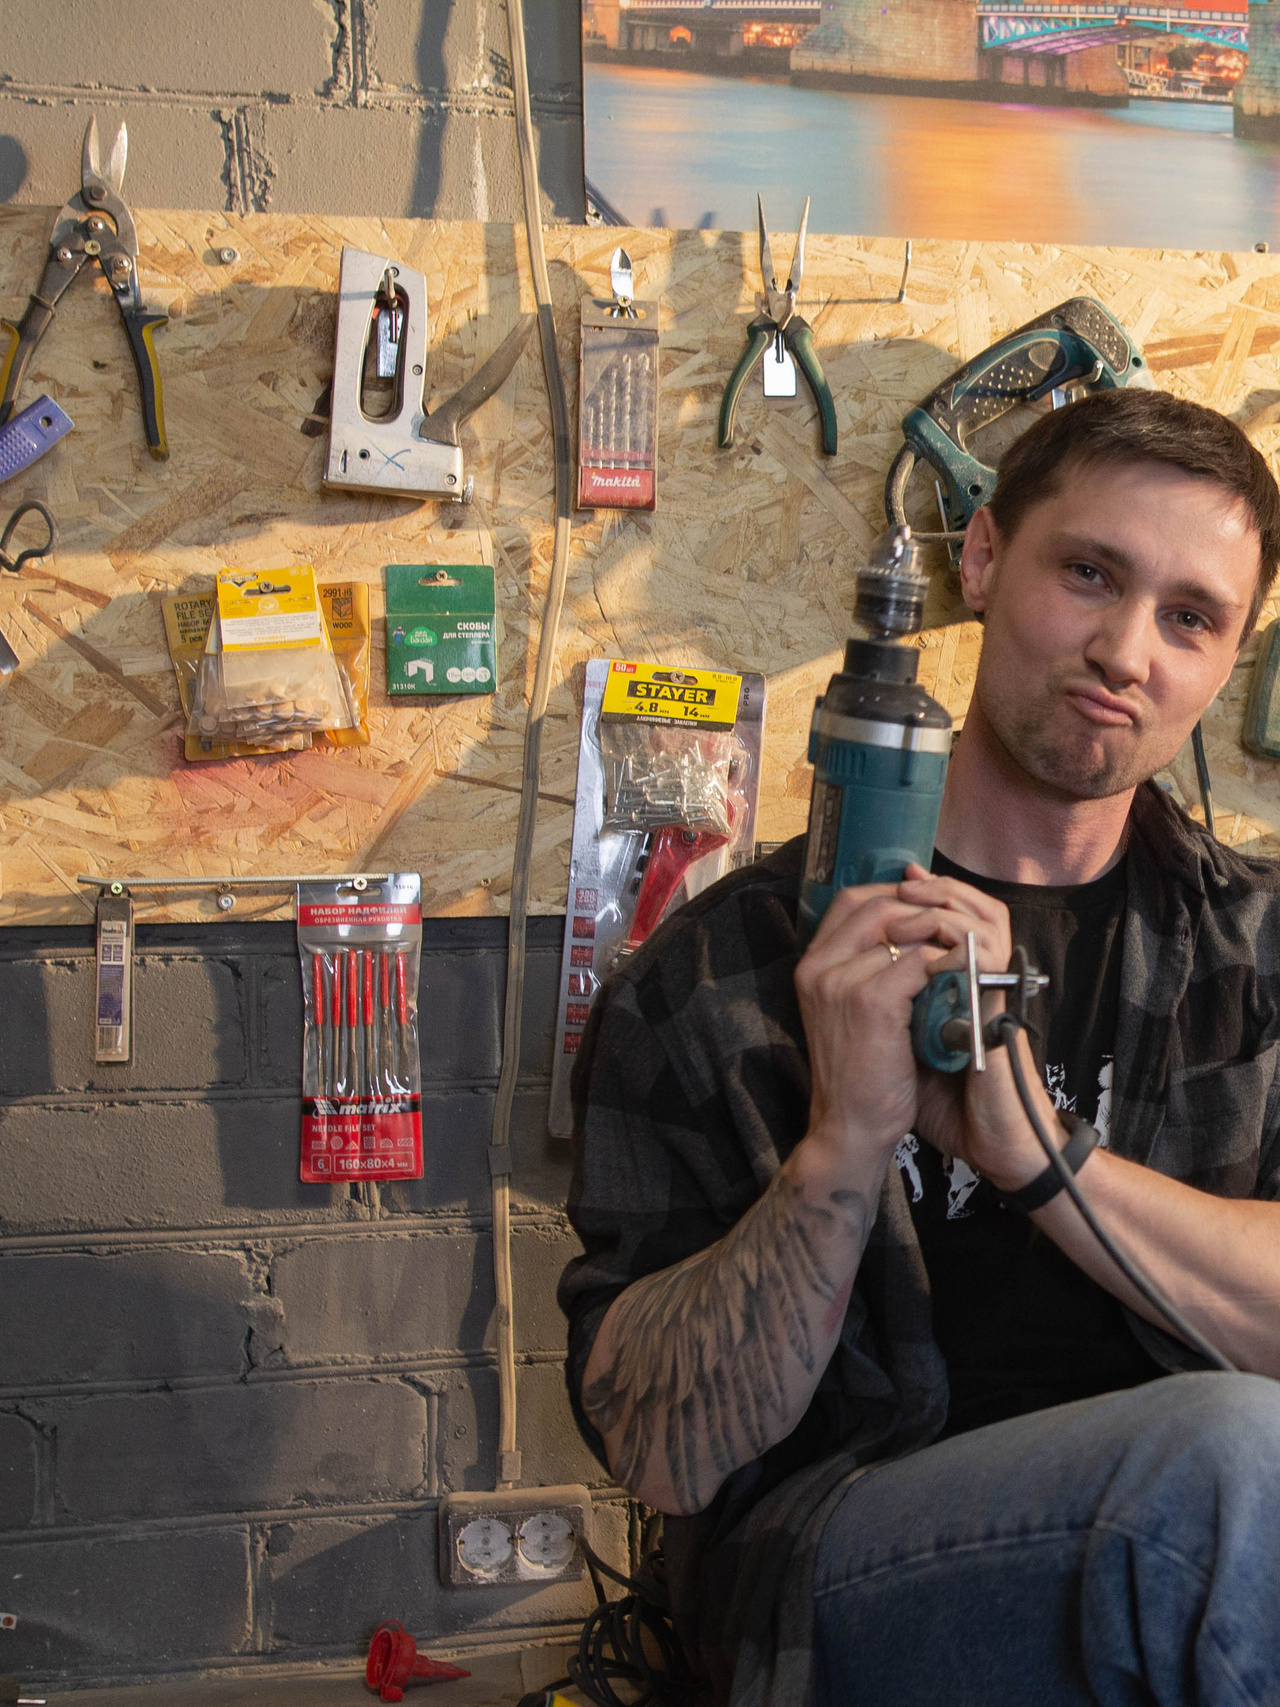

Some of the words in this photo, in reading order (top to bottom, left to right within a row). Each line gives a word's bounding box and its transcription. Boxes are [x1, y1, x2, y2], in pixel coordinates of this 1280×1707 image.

[591, 474, 641, 487] makita
[174, 599, 212, 611] ROTARY
[176, 610, 195, 620] FILE
[332, 621, 353, 629] WOOD
[457, 622, 490, 631] СКОБЫ
[615, 663, 627, 672] 50
[635, 683, 708, 704] STAYER
[634, 701, 659, 713] 4.8
[683, 706, 699, 717] 14
[310, 907, 346, 916] НАБОР
[348, 905, 407, 915] НАДФИЛЕЙ
[339, 1097, 402, 1114] matrix
[312, 1124, 343, 1133] NEEDLE
[344, 1124, 360, 1132] FILE
[362, 1123, 376, 1132] SET
[317, 1159, 325, 1169] 6
